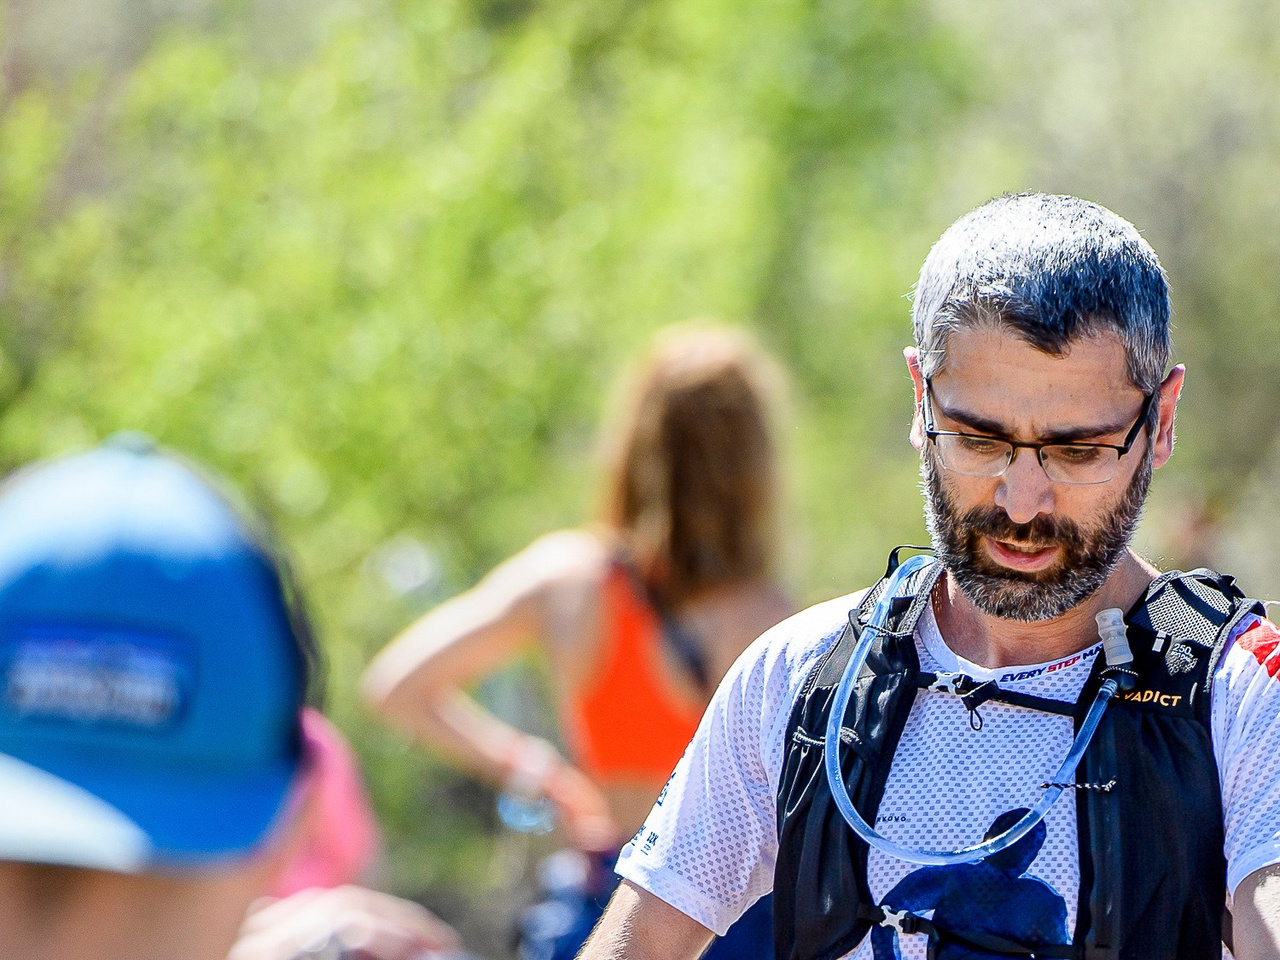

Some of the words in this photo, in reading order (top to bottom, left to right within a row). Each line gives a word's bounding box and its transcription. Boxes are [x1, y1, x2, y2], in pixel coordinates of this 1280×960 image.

[1172, 643, 1192, 655] 250
[999, 667, 1047, 683] EVERY
[1046, 655, 1081, 673] STEP
